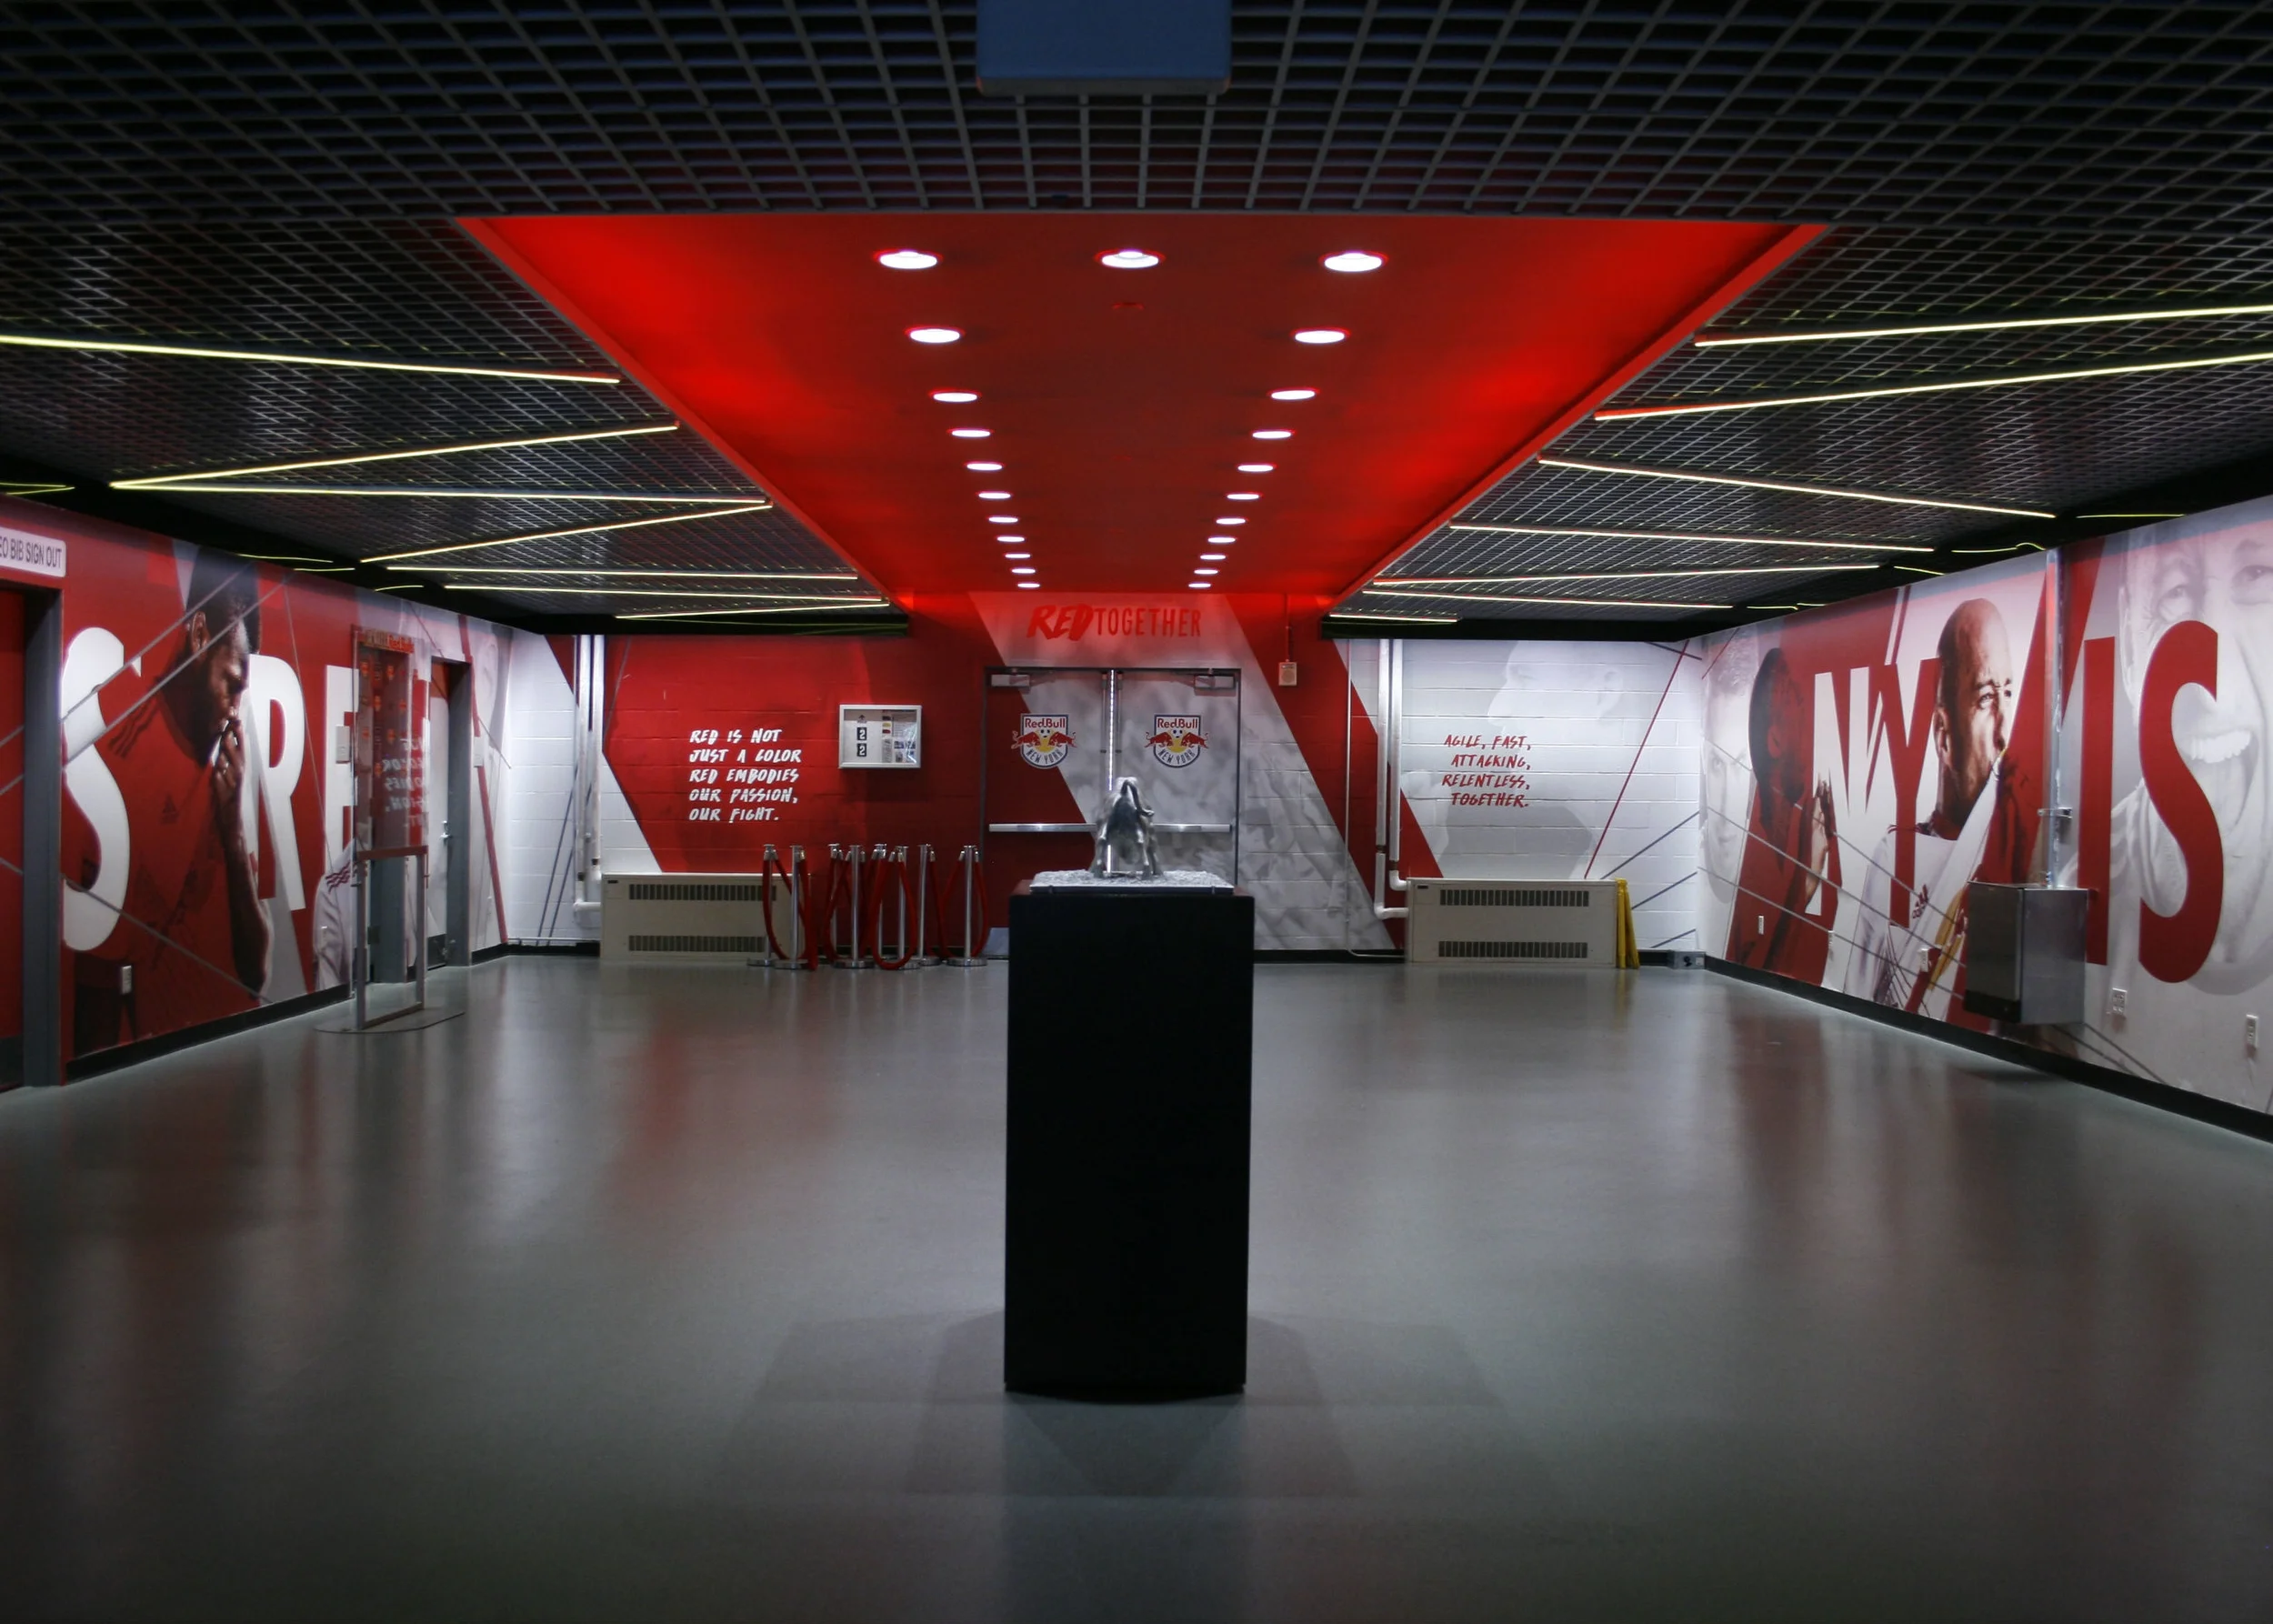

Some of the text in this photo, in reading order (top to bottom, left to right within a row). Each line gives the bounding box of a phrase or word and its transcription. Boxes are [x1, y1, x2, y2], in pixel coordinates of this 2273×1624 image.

[10, 537, 24, 561] BIB
[25, 542, 45, 565] SIGN
[45, 546, 63, 568] OUT
[1026, 603, 1202, 641] RED TOGETHER
[689, 728, 782, 745] RED IS NOT
[858, 728, 866, 740] 2
[1444, 734, 1531, 750] AGILE, FAST,
[689, 748, 802, 763] JUST A COLOR
[858, 745, 866, 757] 2
[1026, 748, 1042, 764] NEW
[1157, 748, 1174, 764] NEW
[1451, 755, 1531, 770] ATTACKING,
[689, 768, 799, 784] RED EMBODIES
[1442, 774, 1530, 790] RELENTLESS,
[689, 787, 798, 804] OUR PASSION,
[1451, 792, 1529, 807] TOGETHER.
[2077, 619, 2225, 984] IS
[689, 807, 779, 823] OUR FIGHT.
